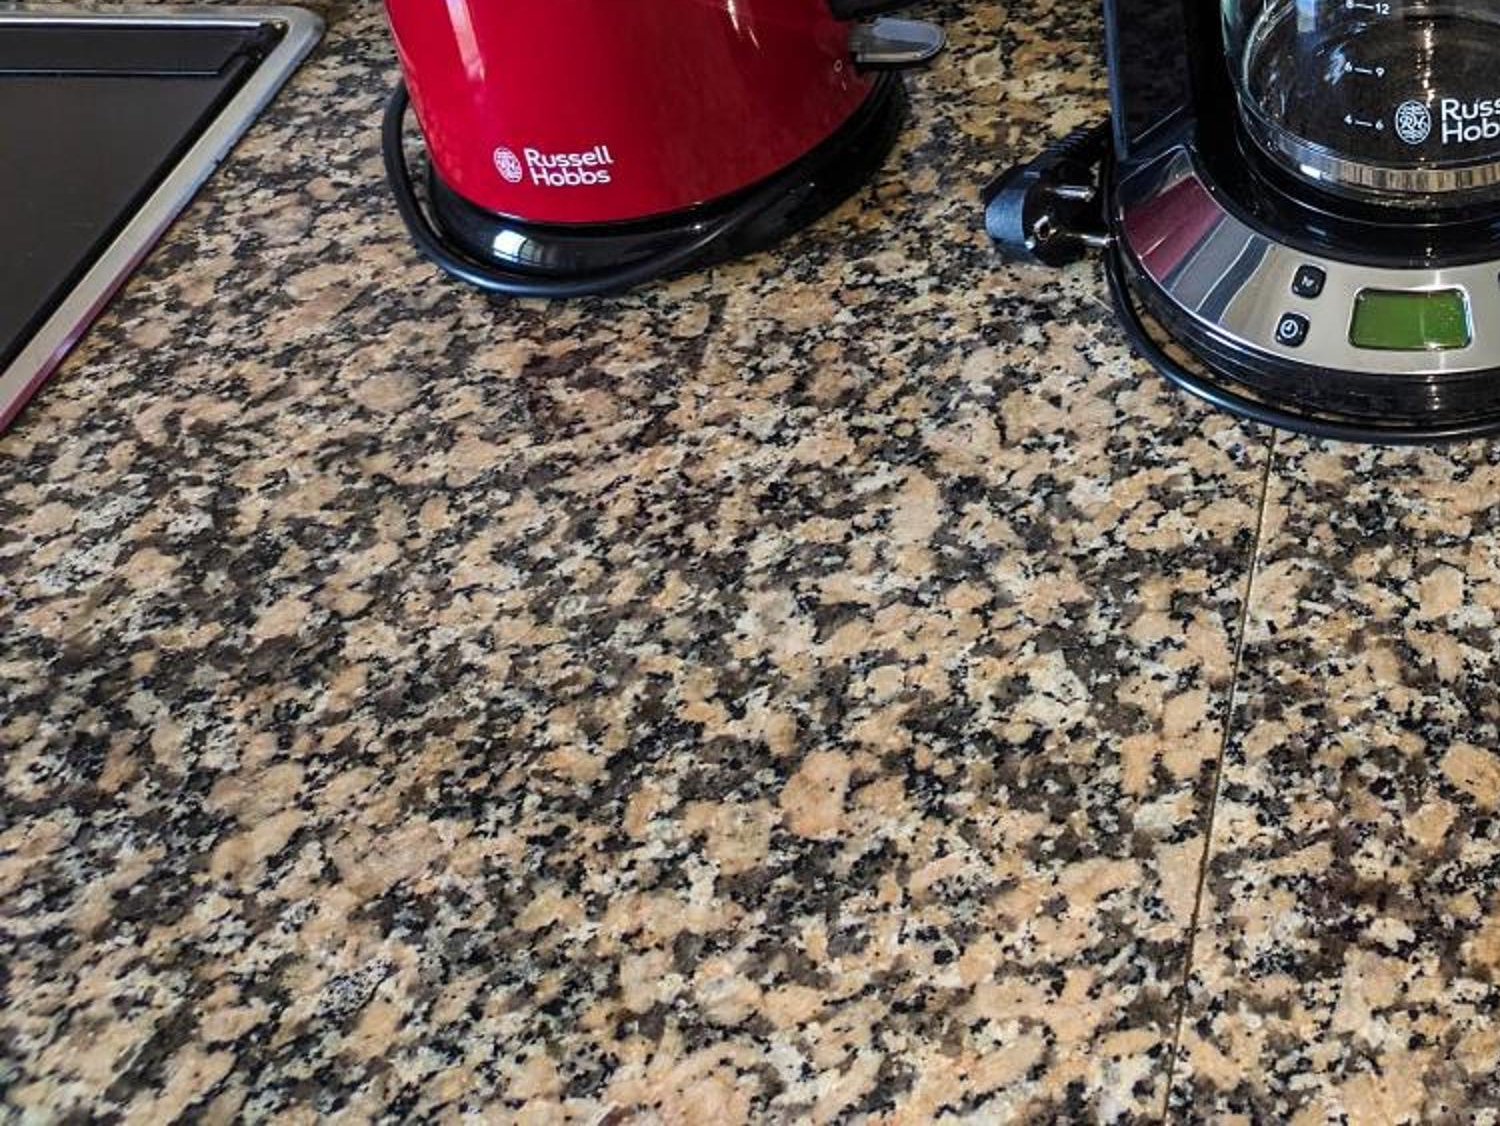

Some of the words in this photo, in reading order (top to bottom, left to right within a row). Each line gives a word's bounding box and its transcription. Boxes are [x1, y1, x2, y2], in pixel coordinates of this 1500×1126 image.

[1374, 2, 1390, 15] 12
[523, 145, 614, 167] Russell
[530, 167, 611, 186] Hobbs
